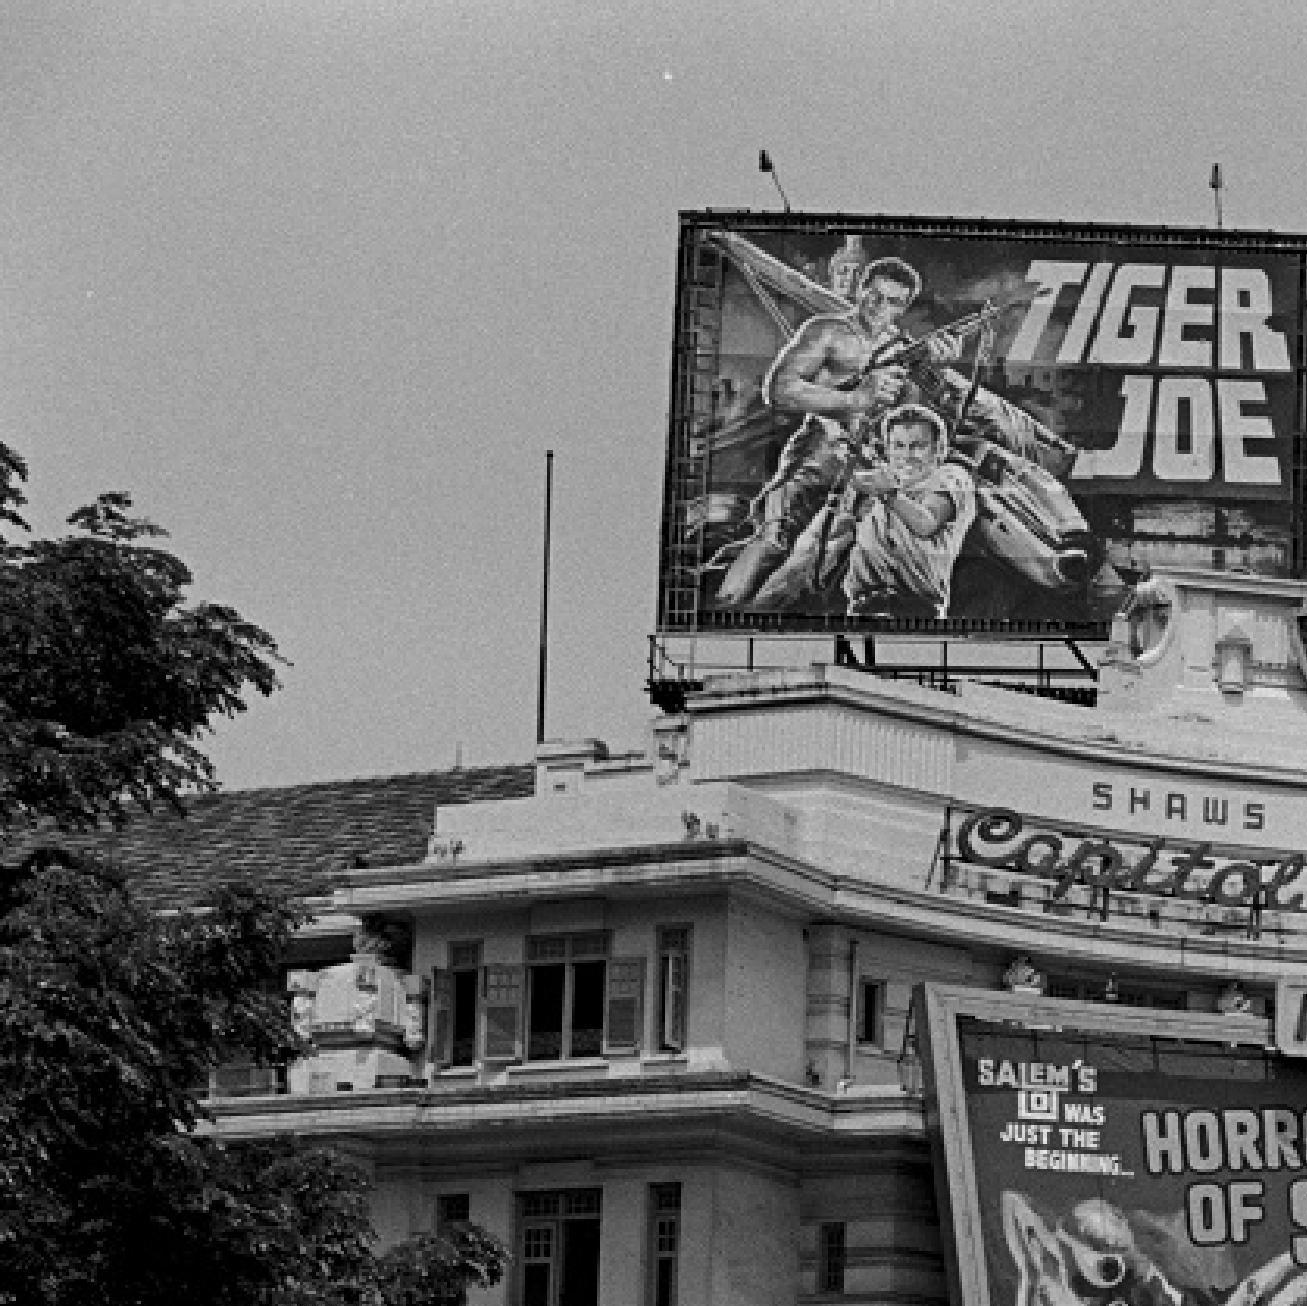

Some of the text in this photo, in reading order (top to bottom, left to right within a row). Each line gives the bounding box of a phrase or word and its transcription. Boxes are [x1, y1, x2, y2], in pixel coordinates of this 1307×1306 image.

[1005, 259, 1291, 371] TIGER
[1071, 375, 1282, 483] JOE
[1092, 781, 1265, 829] SHAWS
[957, 806, 1305, 911] Capitol
[978, 1058, 1098, 1092] SALEM'S
[1000, 1122, 1101, 1150] JUST THE
[1064, 1103, 1106, 1126] WAS
[1188, 1182, 1263, 1246] OF
